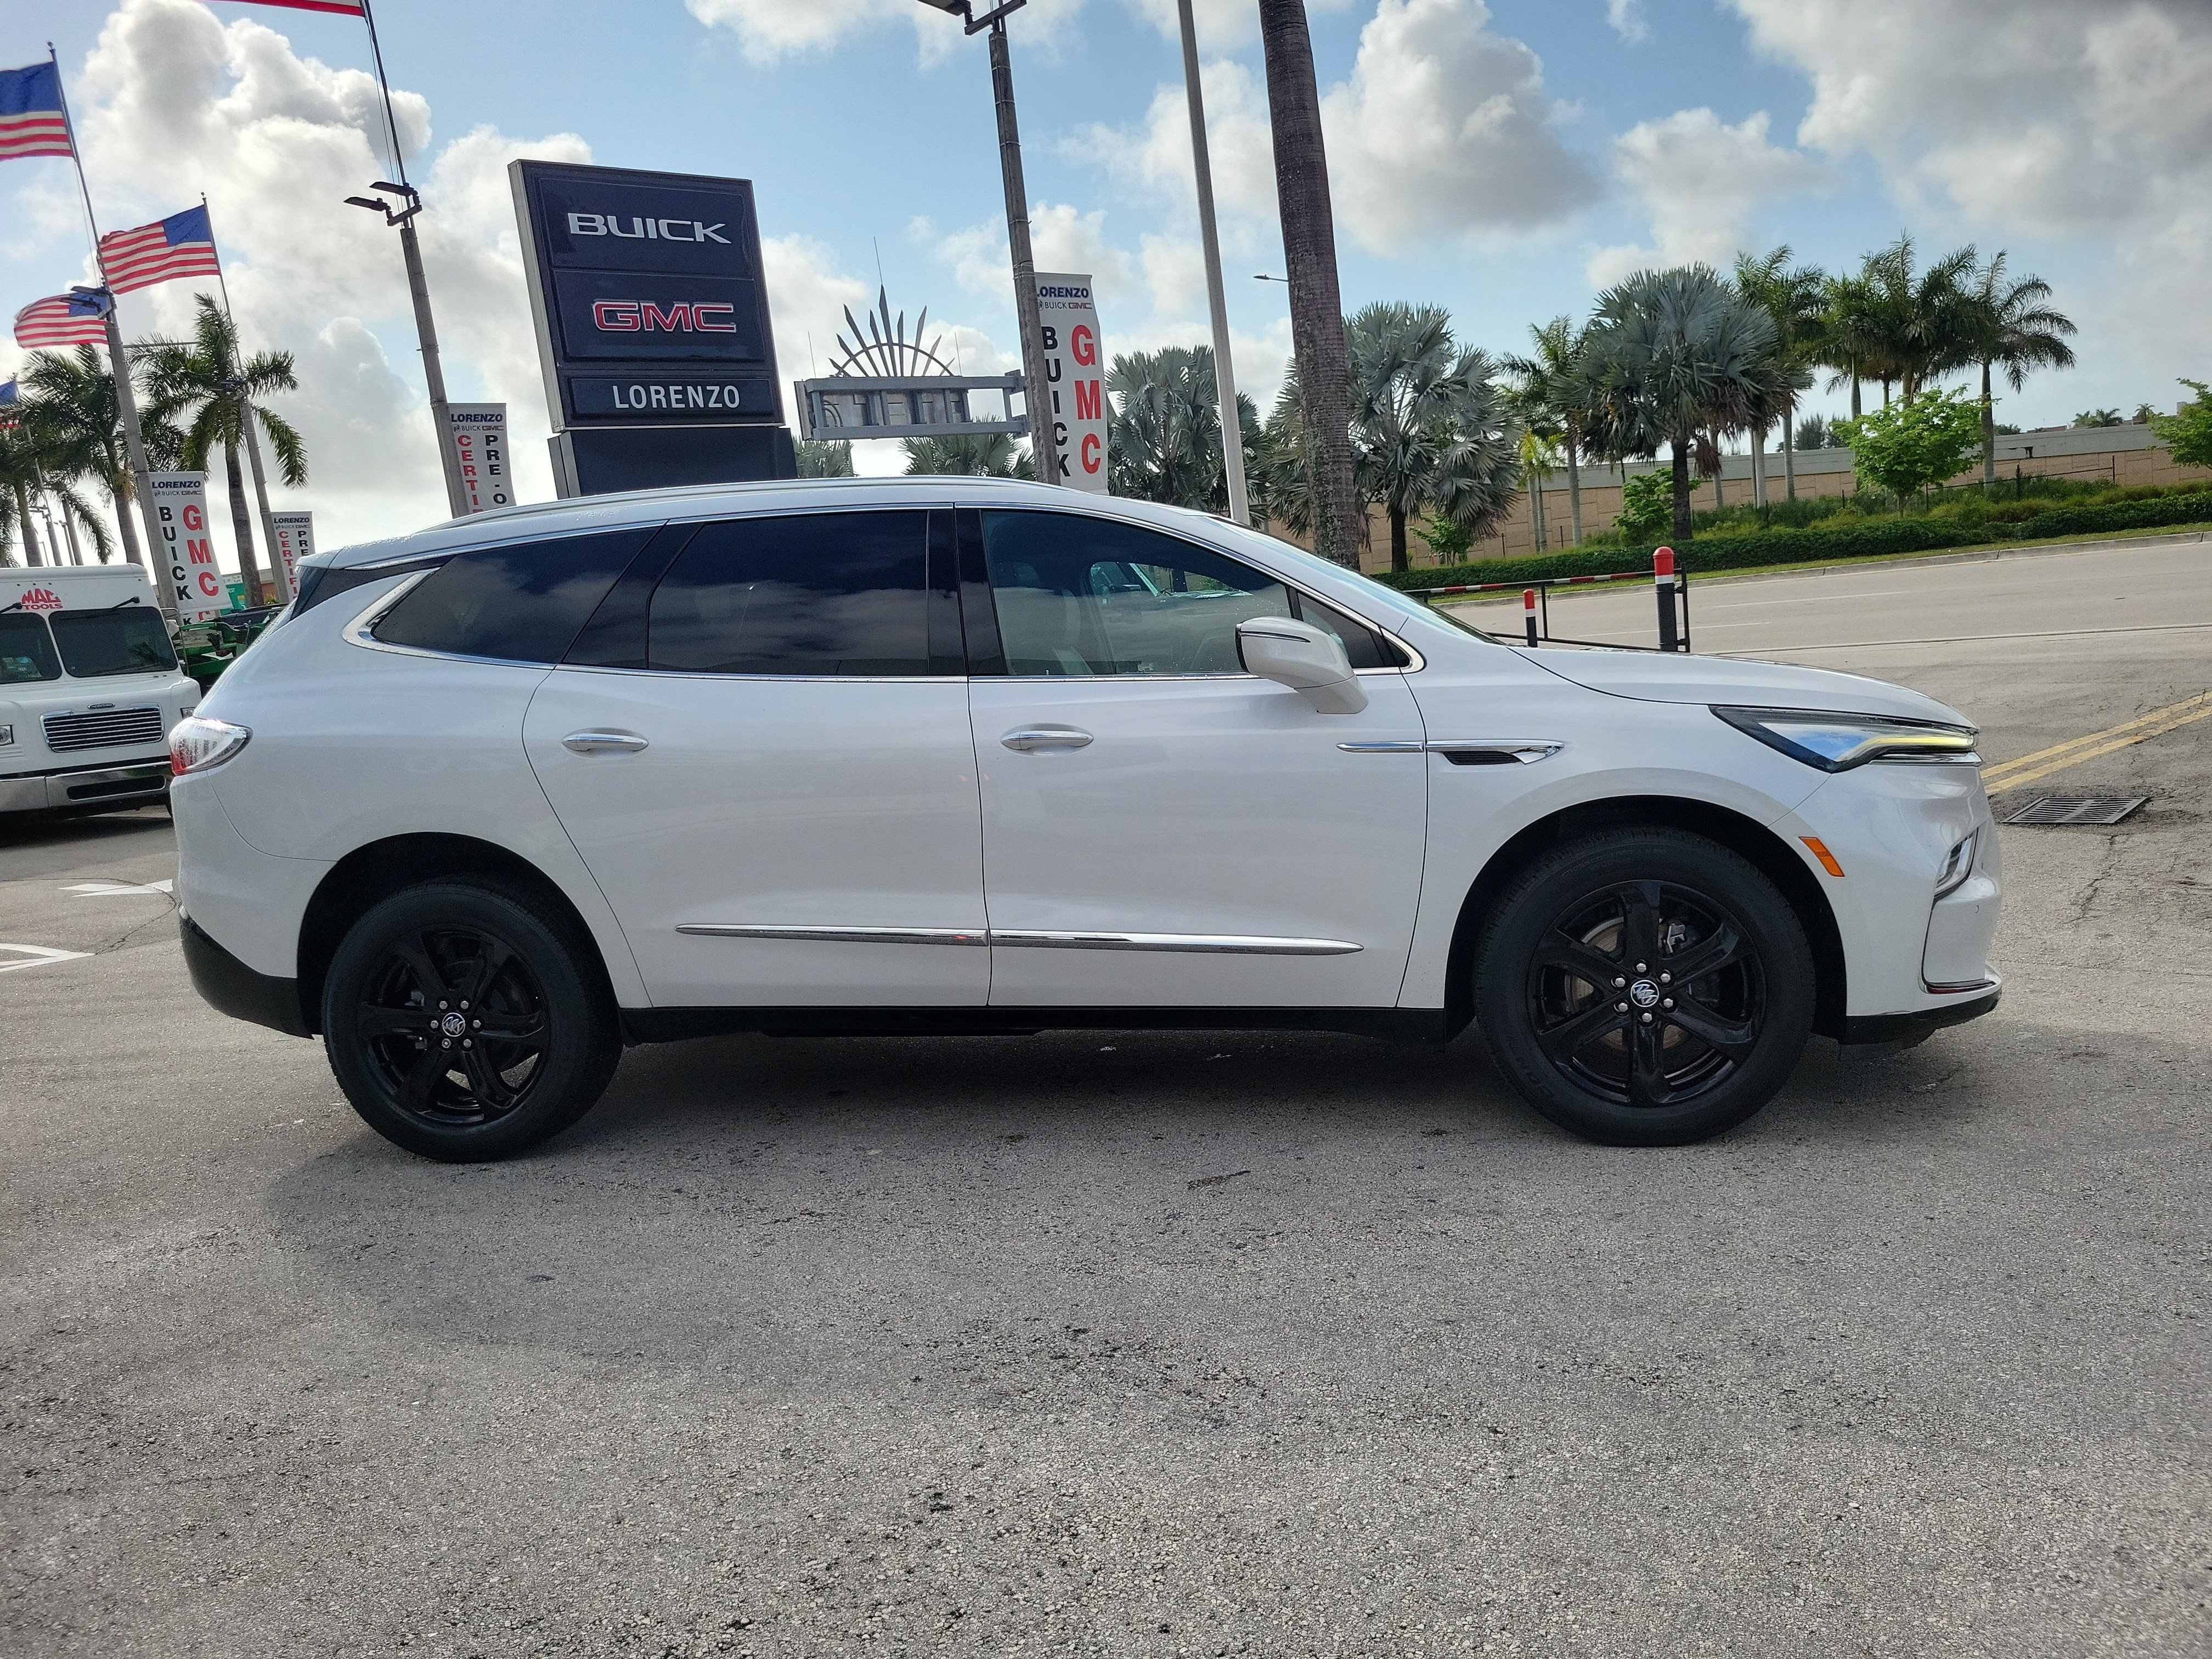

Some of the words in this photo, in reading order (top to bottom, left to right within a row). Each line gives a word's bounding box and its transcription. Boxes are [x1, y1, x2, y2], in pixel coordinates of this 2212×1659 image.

[567, 212, 732, 244] BUICK
[1037, 286, 1090, 298] ORENZO
[592, 300, 737, 333] GMC
[612, 385, 741, 409] LORENZO
[1041, 326, 1071, 477] BUICK
[1071, 324, 1102, 475] GMC
[450, 413, 503, 422] LORENZO
[151, 481, 201, 489] LORENZO
[458, 435, 484, 514] CERTI
[158, 506, 194, 601] BUICK
[183, 504, 219, 597] GMC
[21, 588, 61, 604] MAC
